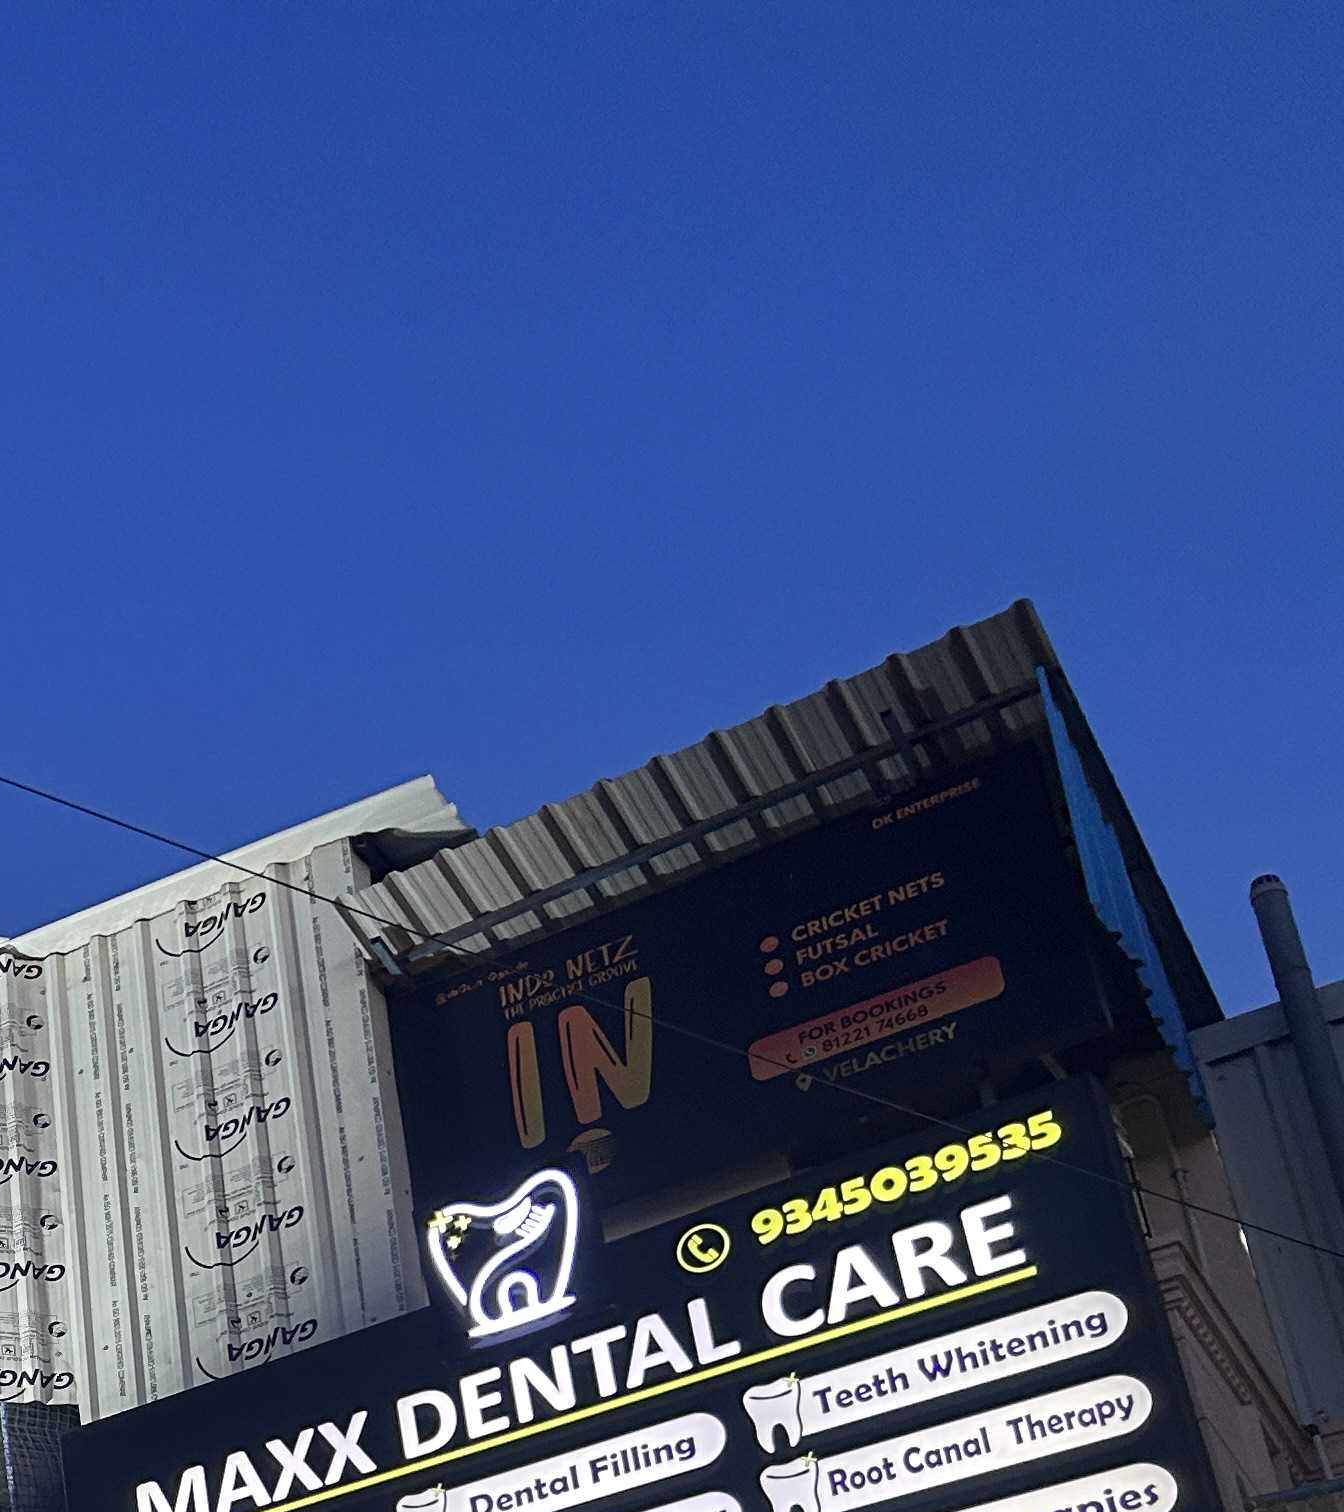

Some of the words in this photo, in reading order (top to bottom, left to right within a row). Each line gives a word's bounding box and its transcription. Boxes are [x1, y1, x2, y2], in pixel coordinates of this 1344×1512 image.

[184, 892, 267, 937] GANGA
[791, 894, 883, 943] CRICKET
[888, 871, 945, 905] NETS
[566, 934, 639, 980] NETZ
[796, 923, 879, 965] FUTSAL
[800, 960, 849, 987] BOX
[855, 919, 948, 966] CRICKET
[194, 992, 279, 1038] GANGA
[798, 1021, 835, 1045] FOR
[841, 980, 947, 1029] BOOKINGS
[822, 1027, 872, 1052] 81221
[877, 1005, 929, 1034] 74668
[507, 976, 653, 1149] IN
[823, 1021, 957, 1082] VELACHERY
[205, 1097, 291, 1142] GANGA
[751, 1110, 1062, 1245] 9345039535
[216, 1205, 304, 1250] GANGA
[227, 1318, 318, 1363] GANGA
[395, 1297, 743, 1461] DENTAL
[760, 1194, 1030, 1338] CARE
[813, 1365, 911, 1416] Teeth
[917, 1307, 1108, 1383] Whitening
[590, 1432, 697, 1484] Filling
[828, 1457, 896, 1498] Root
[903, 1426, 992, 1475] Canal
[1005, 1390, 1134, 1447] Therapy
